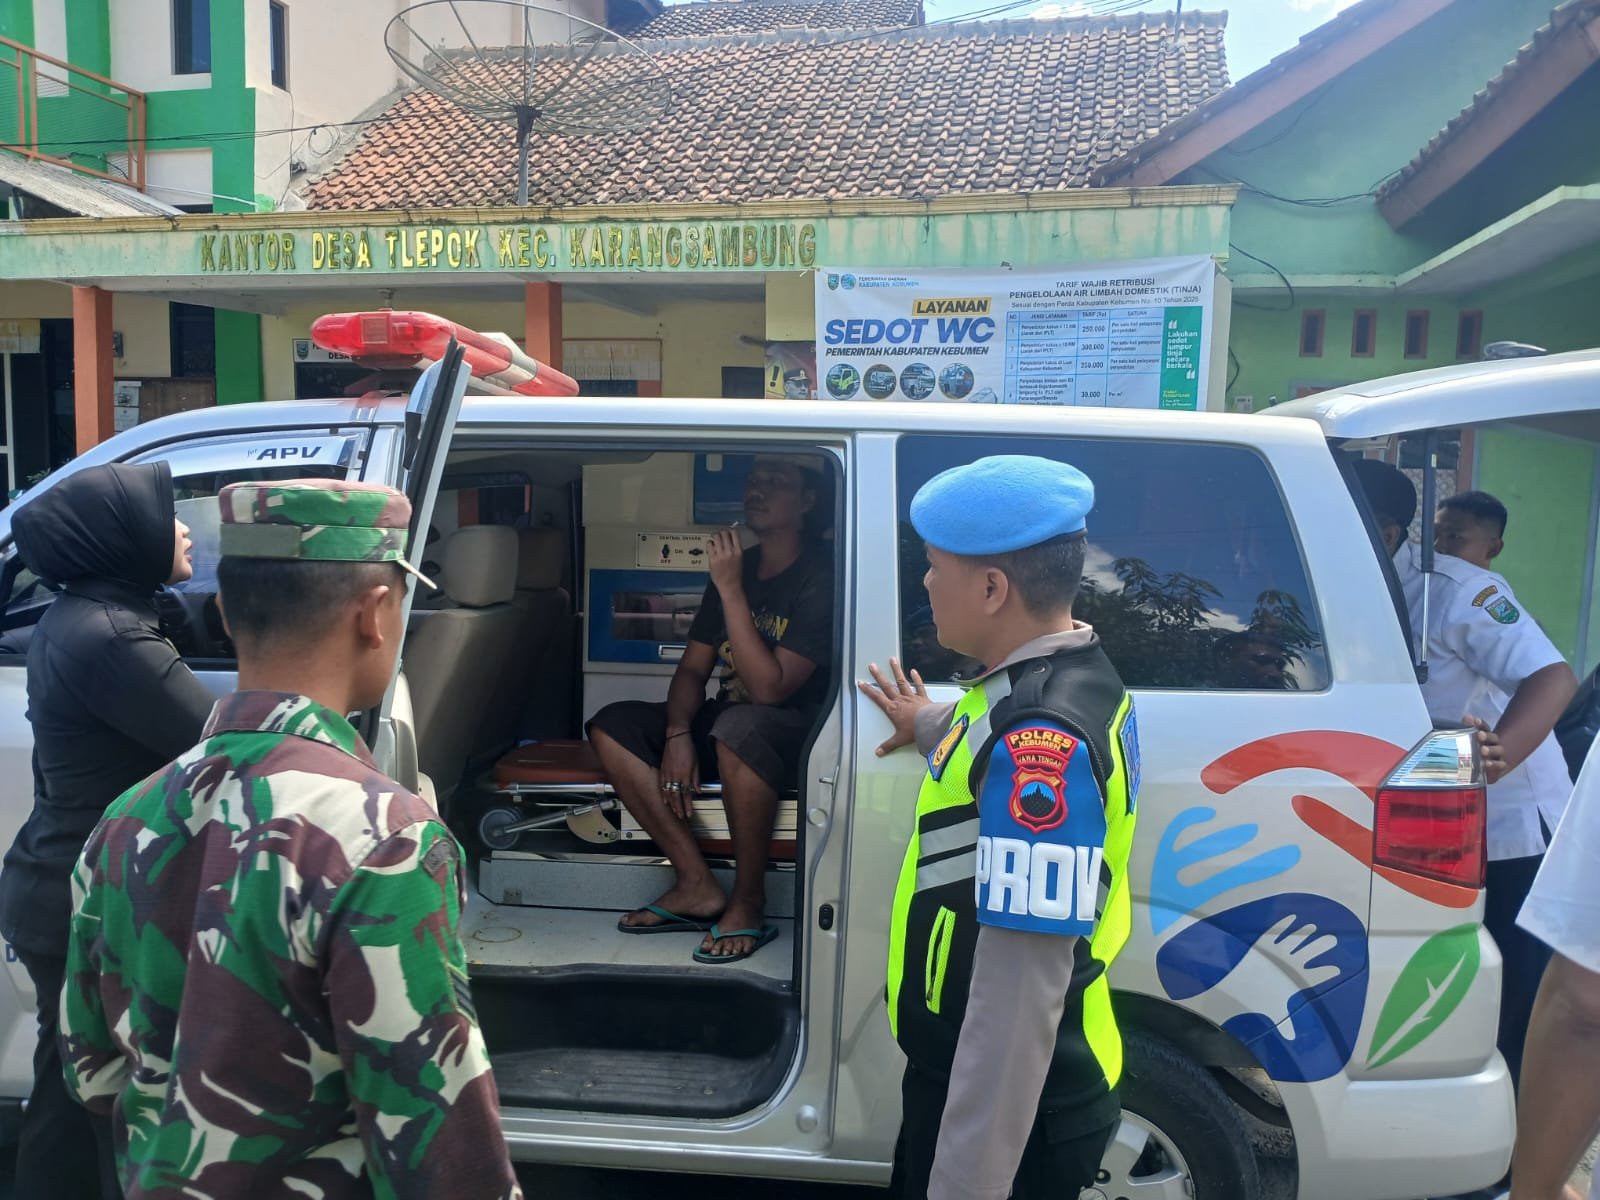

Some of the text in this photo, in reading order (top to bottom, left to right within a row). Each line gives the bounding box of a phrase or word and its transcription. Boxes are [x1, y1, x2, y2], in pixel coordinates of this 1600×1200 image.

[201, 224, 816, 271] KANTOR DESA TLEPOK KEC. KARANGSAMBUNG
[1080, 280, 1108, 288] WAJIB
[1110, 278, 1155, 286] RETRIBUSI
[1010, 290, 1072, 298] PENGELOLAAN
[1090, 288, 1122, 296] LIMBAH
[1124, 287, 1168, 296] DOMESTIK
[1172, 286, 1202, 294] (TINJA)
[916, 300, 988, 314] LAYANAN
[1032, 301, 1056, 309] dengan
[1076, 300, 1108, 308] Kabupaten
[824, 317, 996, 344] SEDOT WC
[826, 346, 988, 356] PEMERINTAH KABUPATEN KEBUMEN
[256, 446, 322, 460] APV
[1010, 730, 1073, 748] POLRES
[1018, 740, 1060, 751] KEBUMEN
[1018, 755, 1036, 764] JAWA
